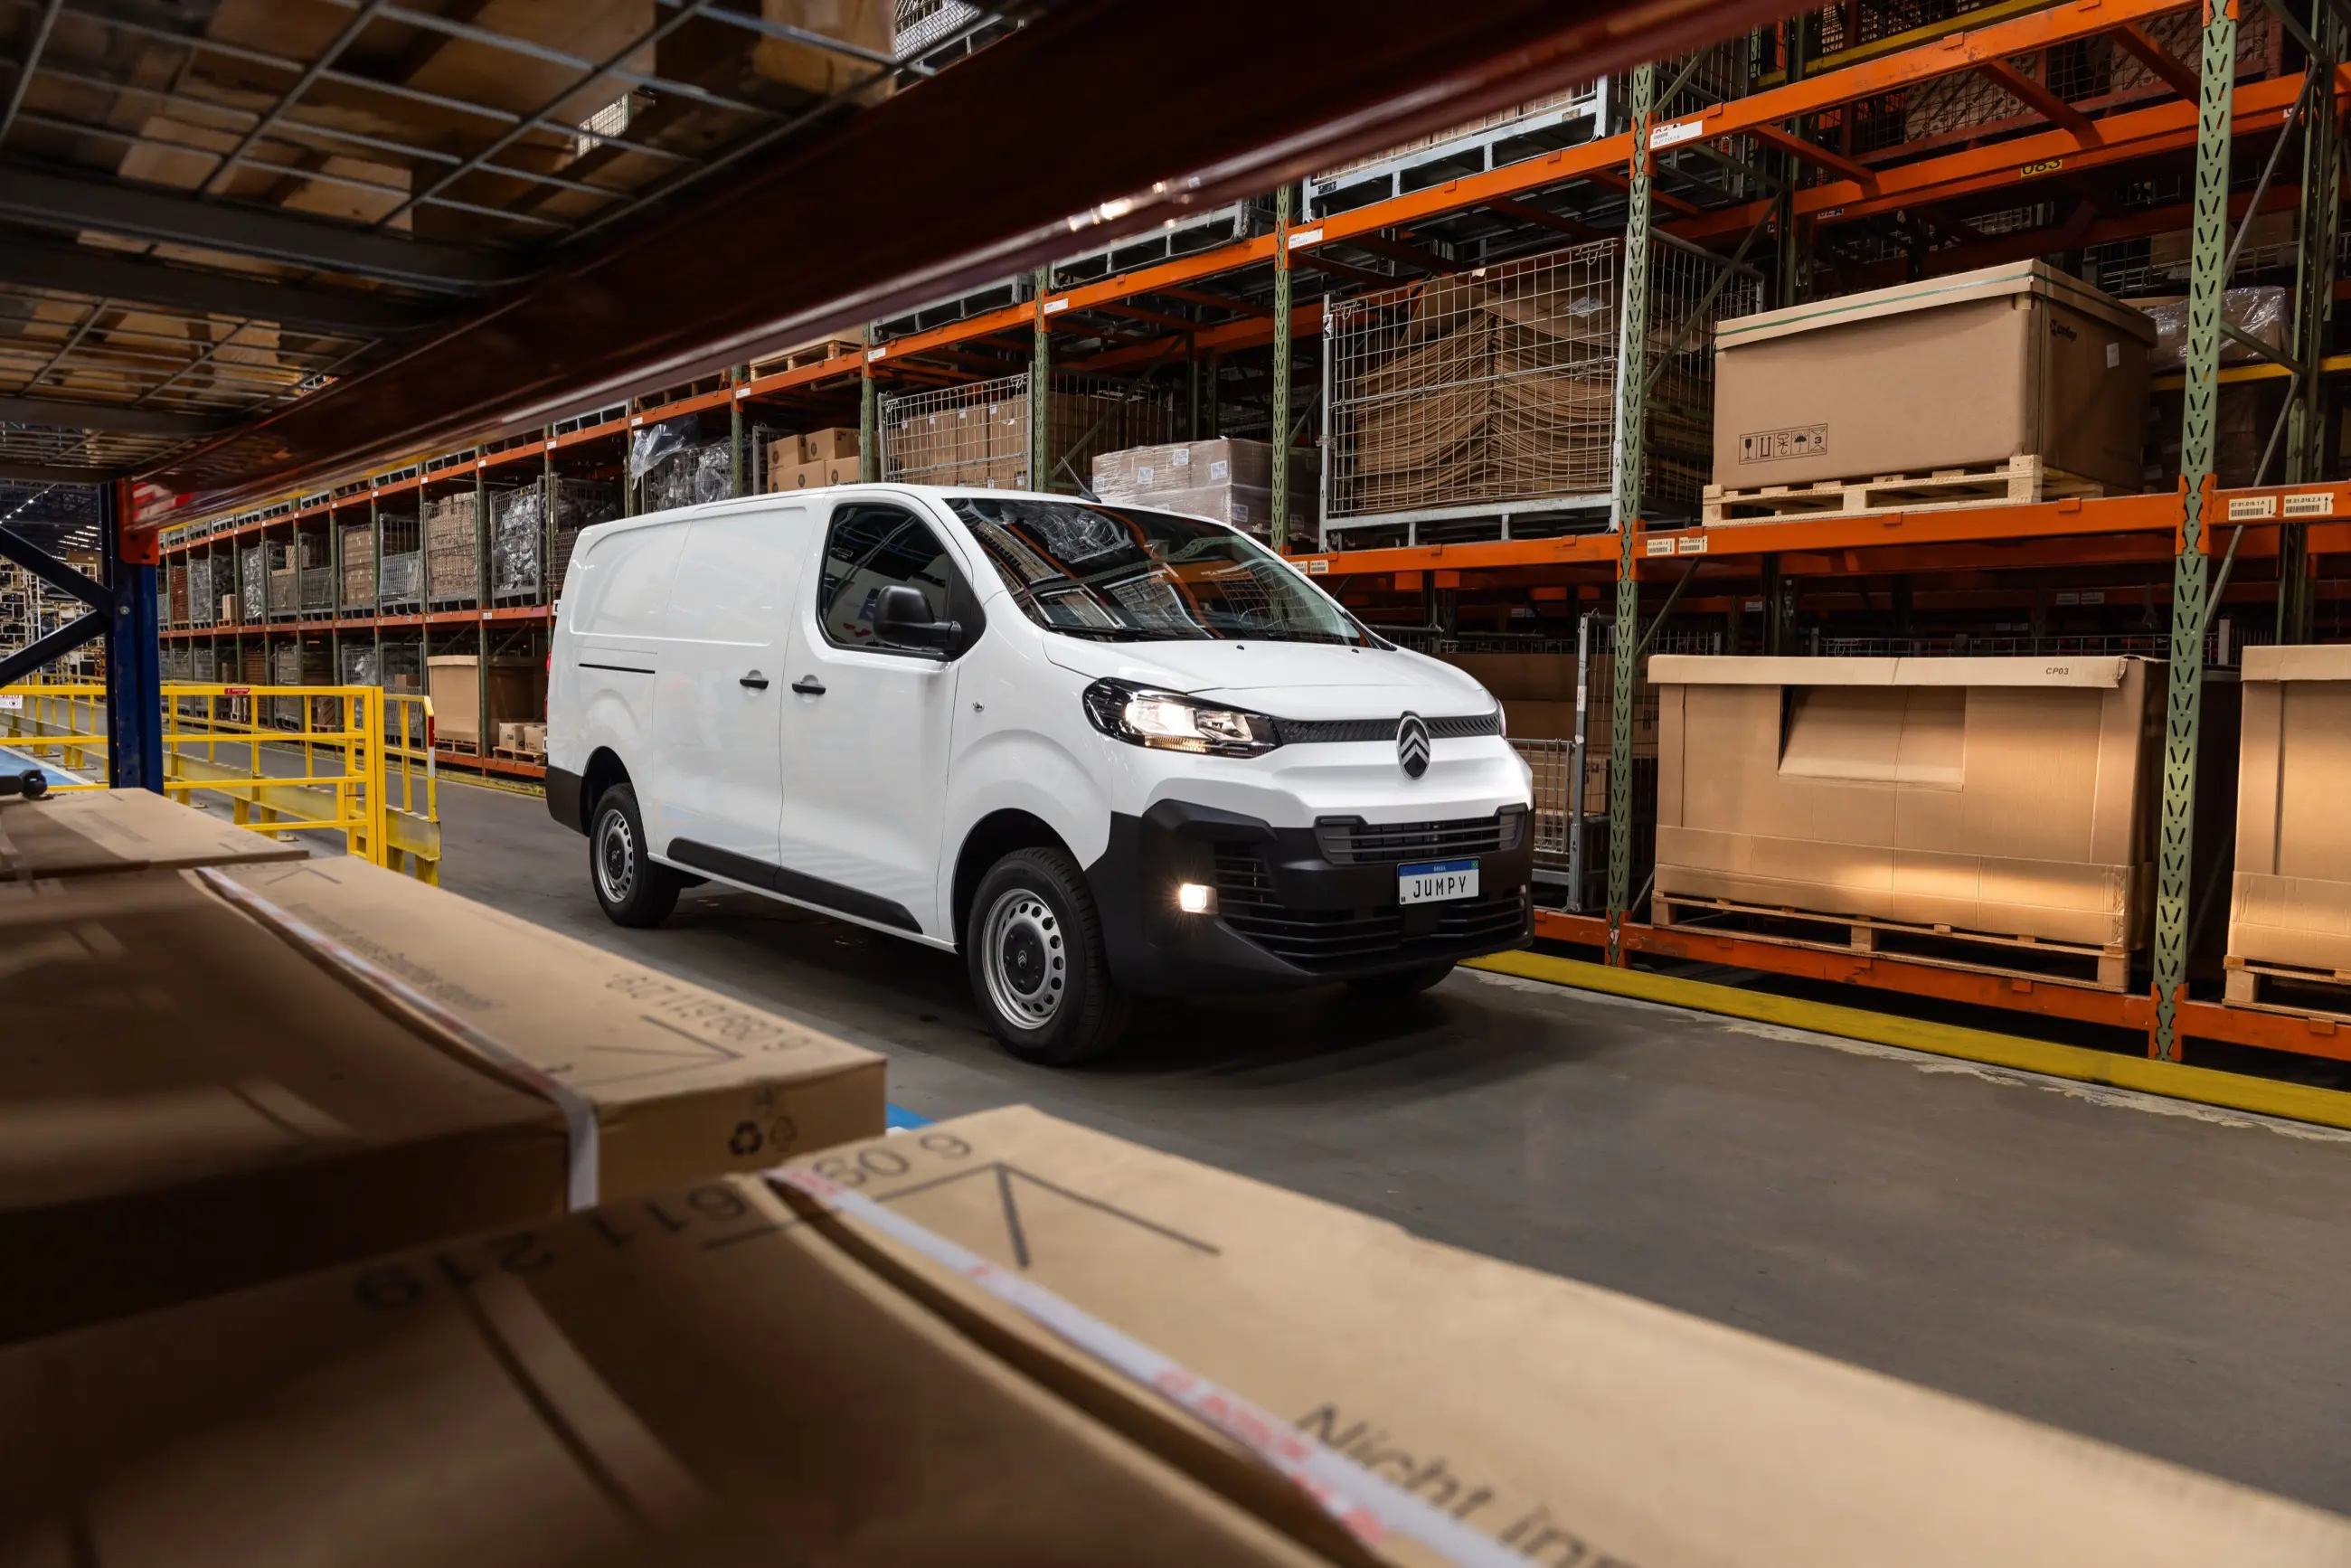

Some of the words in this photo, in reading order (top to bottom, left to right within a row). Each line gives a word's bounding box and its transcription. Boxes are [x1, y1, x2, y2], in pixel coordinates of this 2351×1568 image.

[1814, 436, 1822, 444] 3
[2046, 667, 2069, 675] CP03
[1413, 875, 1467, 898] JUMPY
